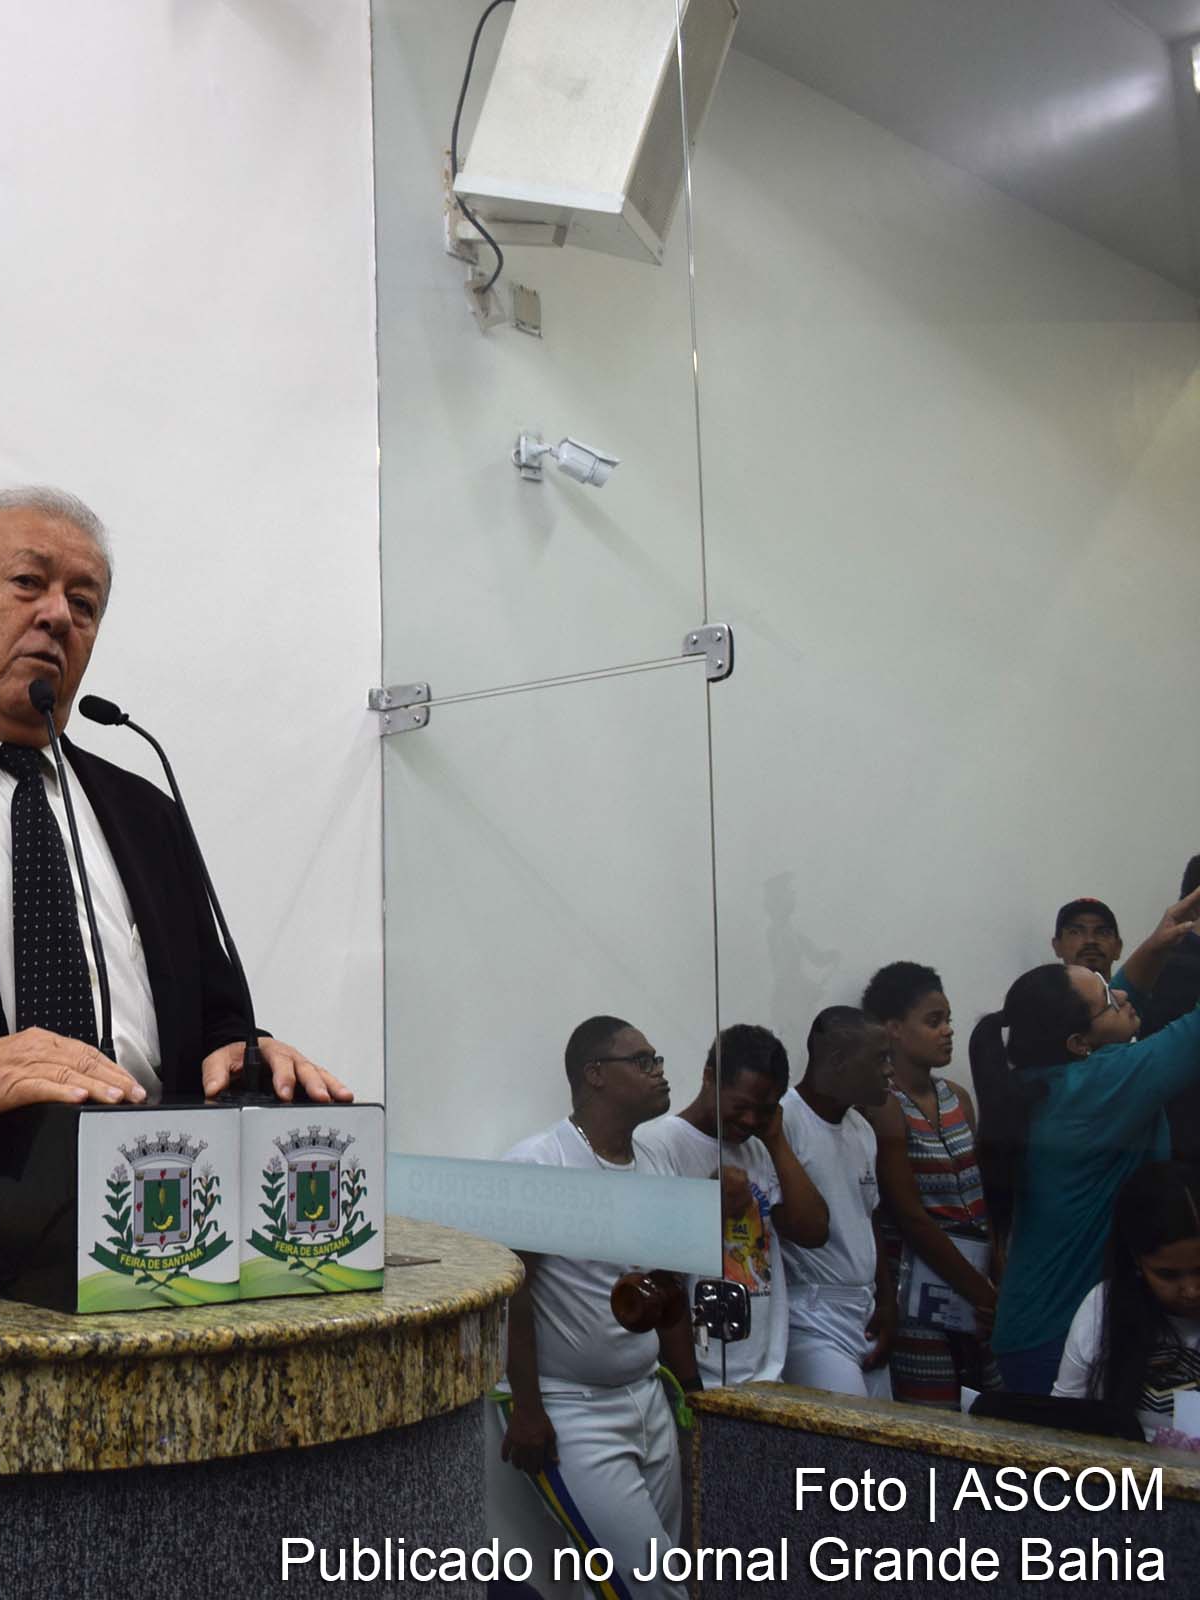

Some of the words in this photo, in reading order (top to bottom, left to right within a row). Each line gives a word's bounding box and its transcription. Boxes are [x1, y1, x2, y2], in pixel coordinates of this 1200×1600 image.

[275, 1240, 299, 1256] FEIRA
[300, 1246, 313, 1256] DE
[314, 1236, 351, 1255] SANTANA
[120, 1254, 146, 1268] FEIRA
[147, 1259, 160, 1269] DE
[162, 1248, 204, 1268] SANTANA
